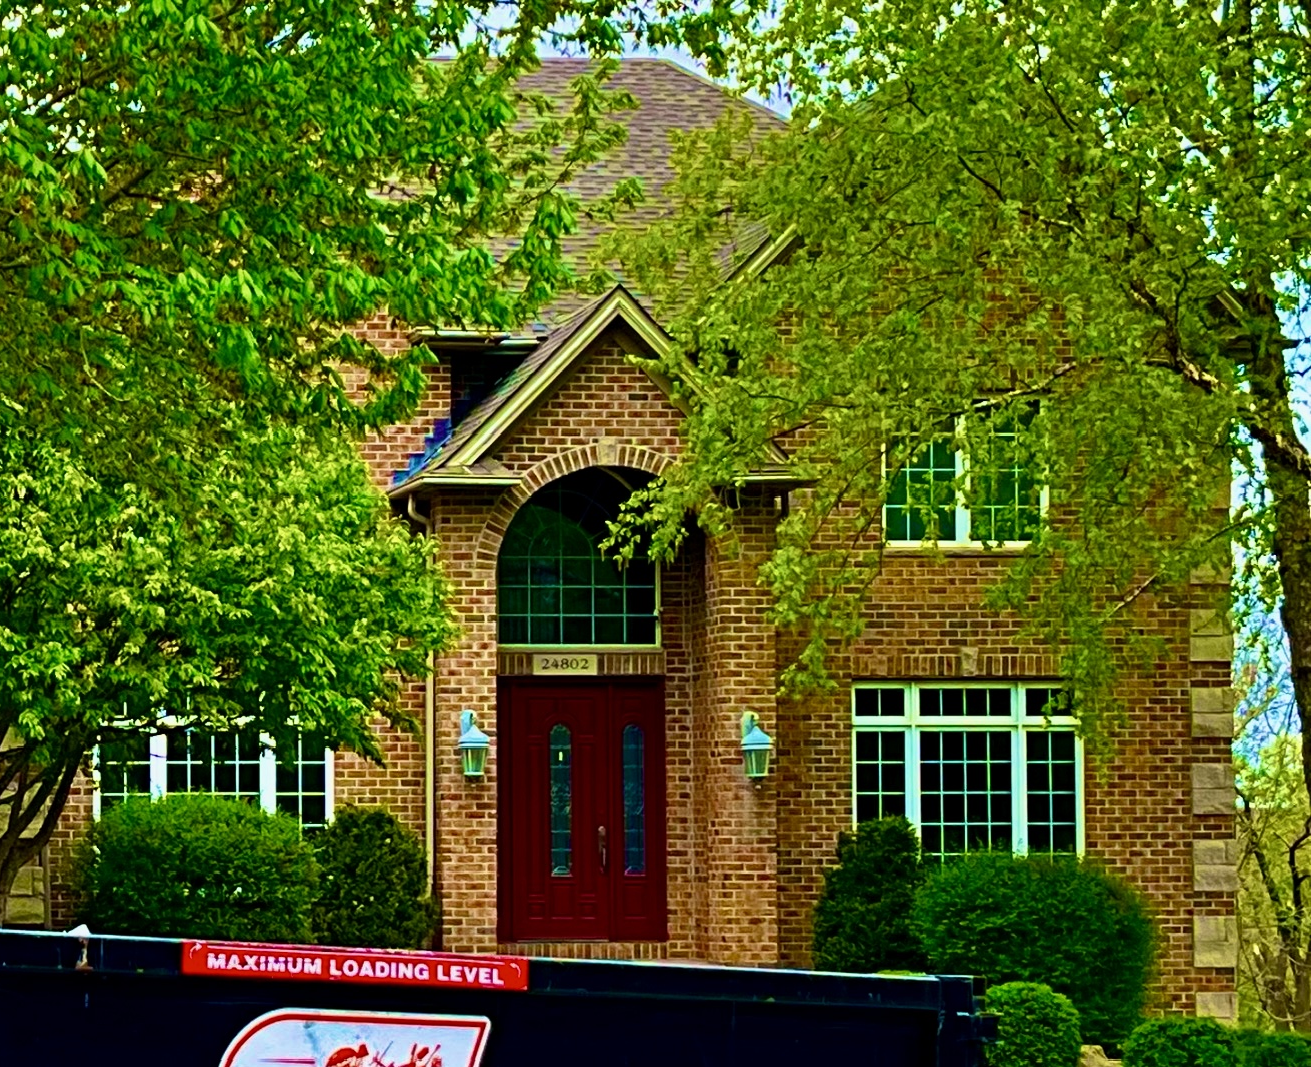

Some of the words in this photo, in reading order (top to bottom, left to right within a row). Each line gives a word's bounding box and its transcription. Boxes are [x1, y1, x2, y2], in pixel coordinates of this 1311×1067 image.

[541, 658, 589, 670] 24802
[207, 953, 322, 975] MAXIMUM
[329, 959, 430, 981] LOADING
[437, 964, 505, 986] LEVEL
